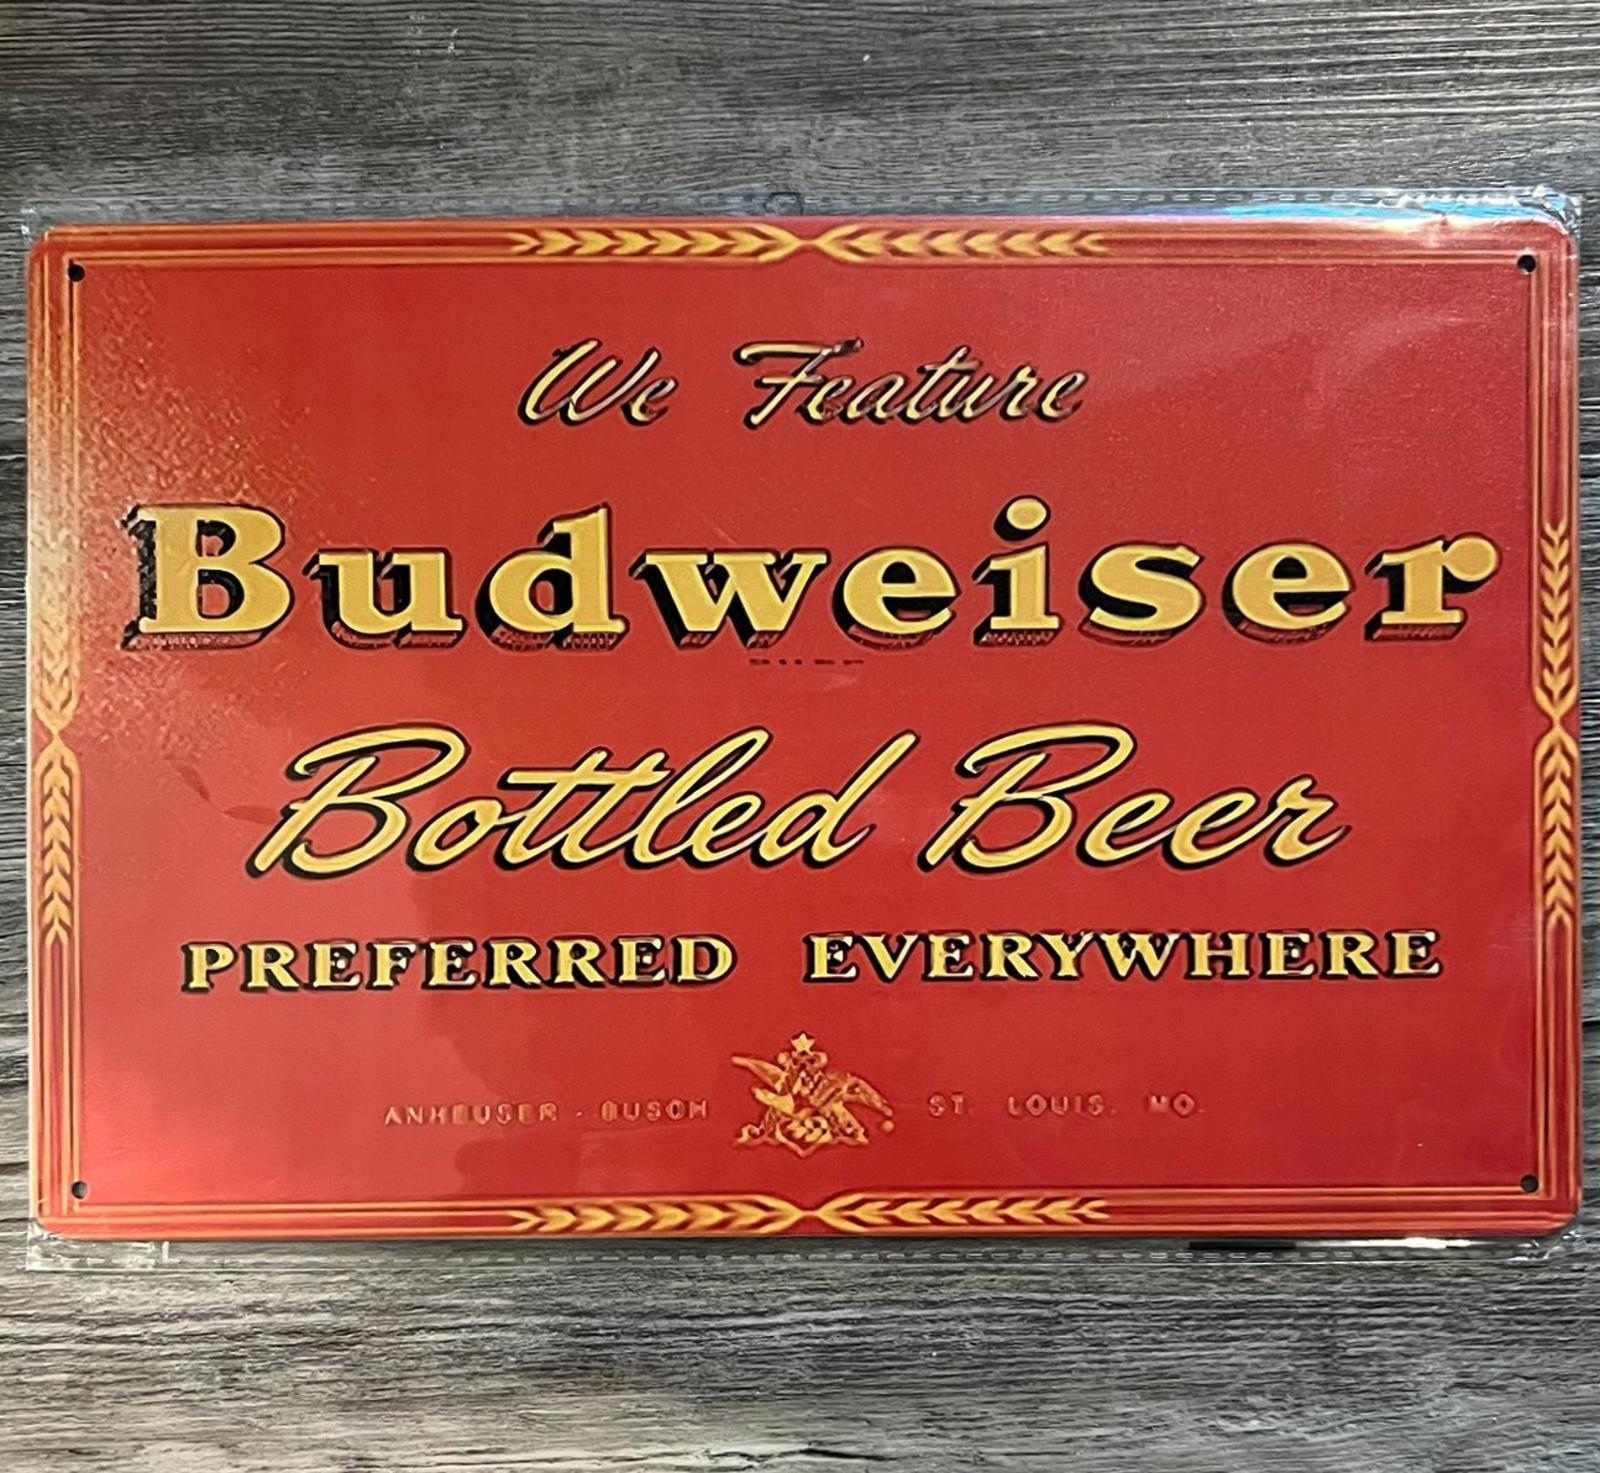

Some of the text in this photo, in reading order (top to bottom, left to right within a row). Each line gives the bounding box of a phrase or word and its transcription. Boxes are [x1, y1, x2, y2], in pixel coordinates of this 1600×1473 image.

[517, 337, 1087, 430] We Feature
[122, 495, 1501, 651] Budweiser
[246, 721, 1352, 880] Bottled Beer
[181, 929, 1443, 993] PREFERRED EVERYWHERE
